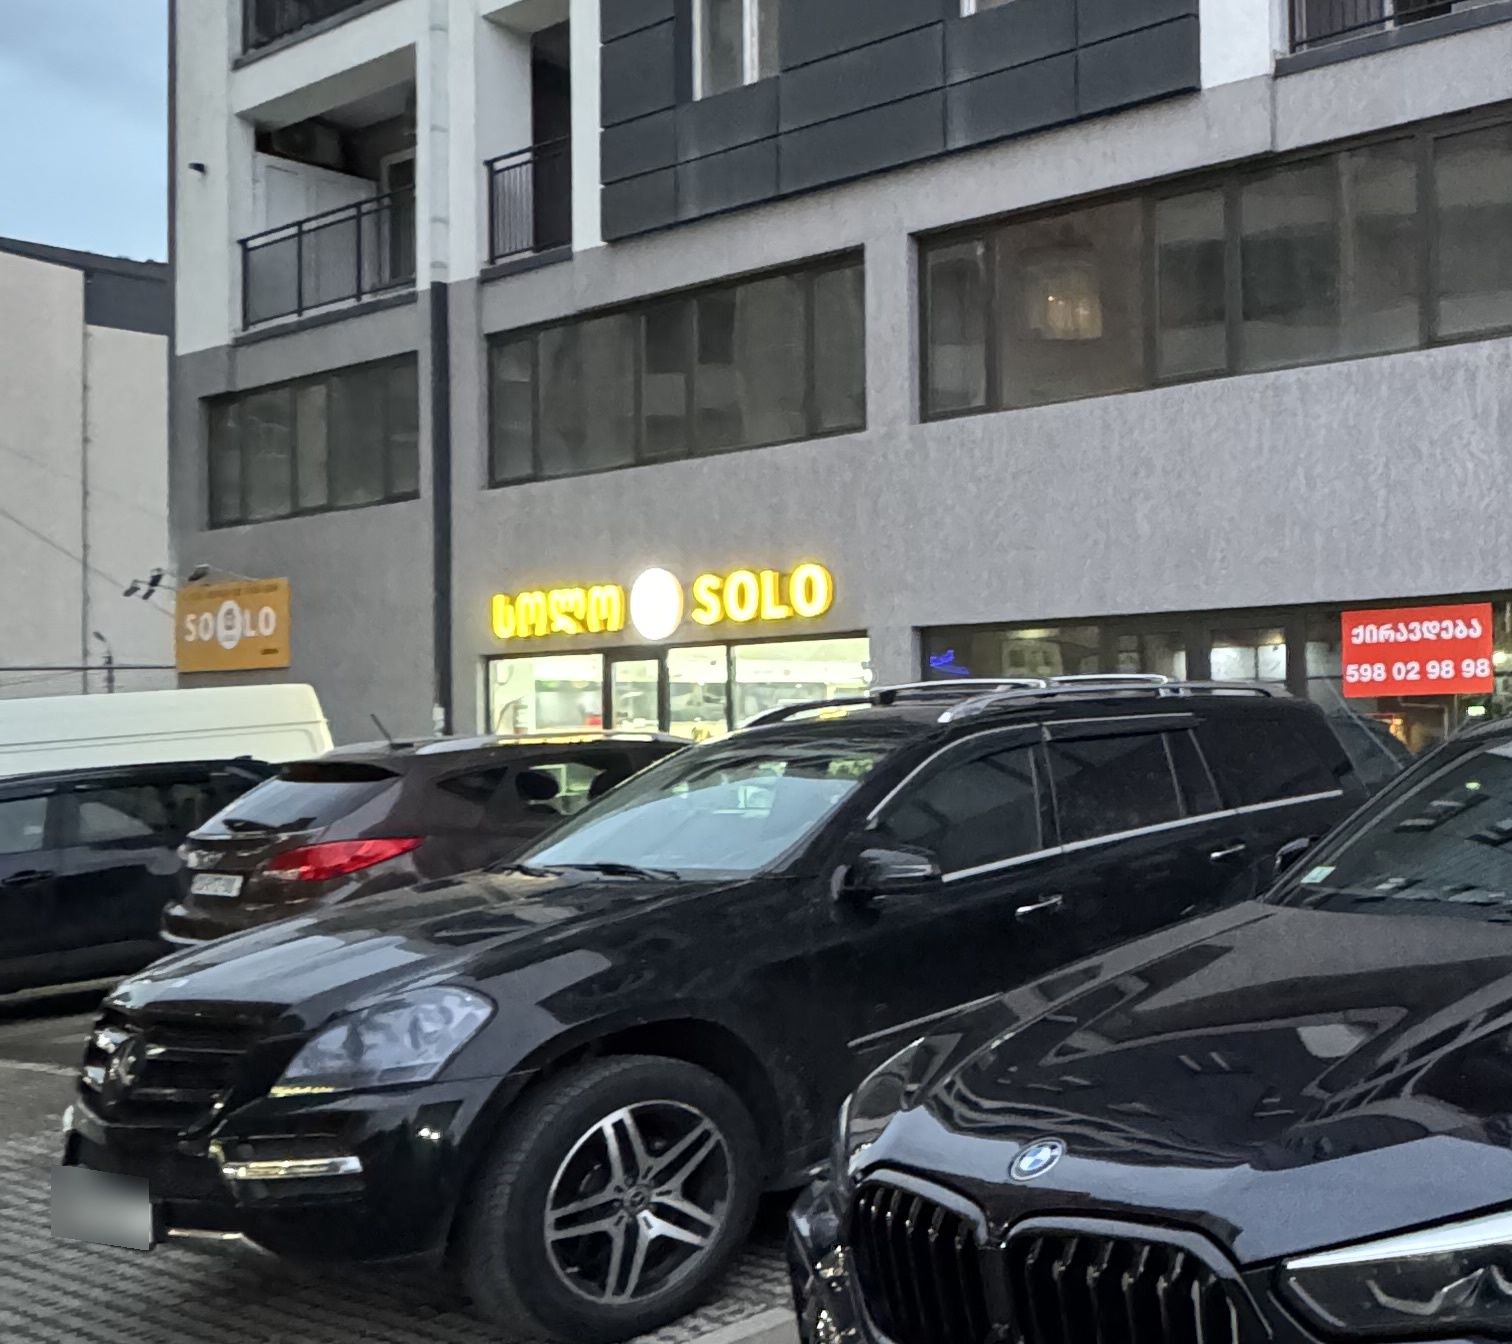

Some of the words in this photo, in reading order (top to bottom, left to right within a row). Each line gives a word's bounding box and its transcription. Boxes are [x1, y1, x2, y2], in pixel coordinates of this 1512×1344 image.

[492, 584, 625, 639] სოლო
[691, 563, 833, 627] SOLO
[1350, 617, 1483, 645] ქირავდება
[1345, 662, 1388, 683] 598
[1392, 660, 1421, 682] 02
[1425, 659, 1456, 680] 98
[1461, 657, 1492, 679] 98
